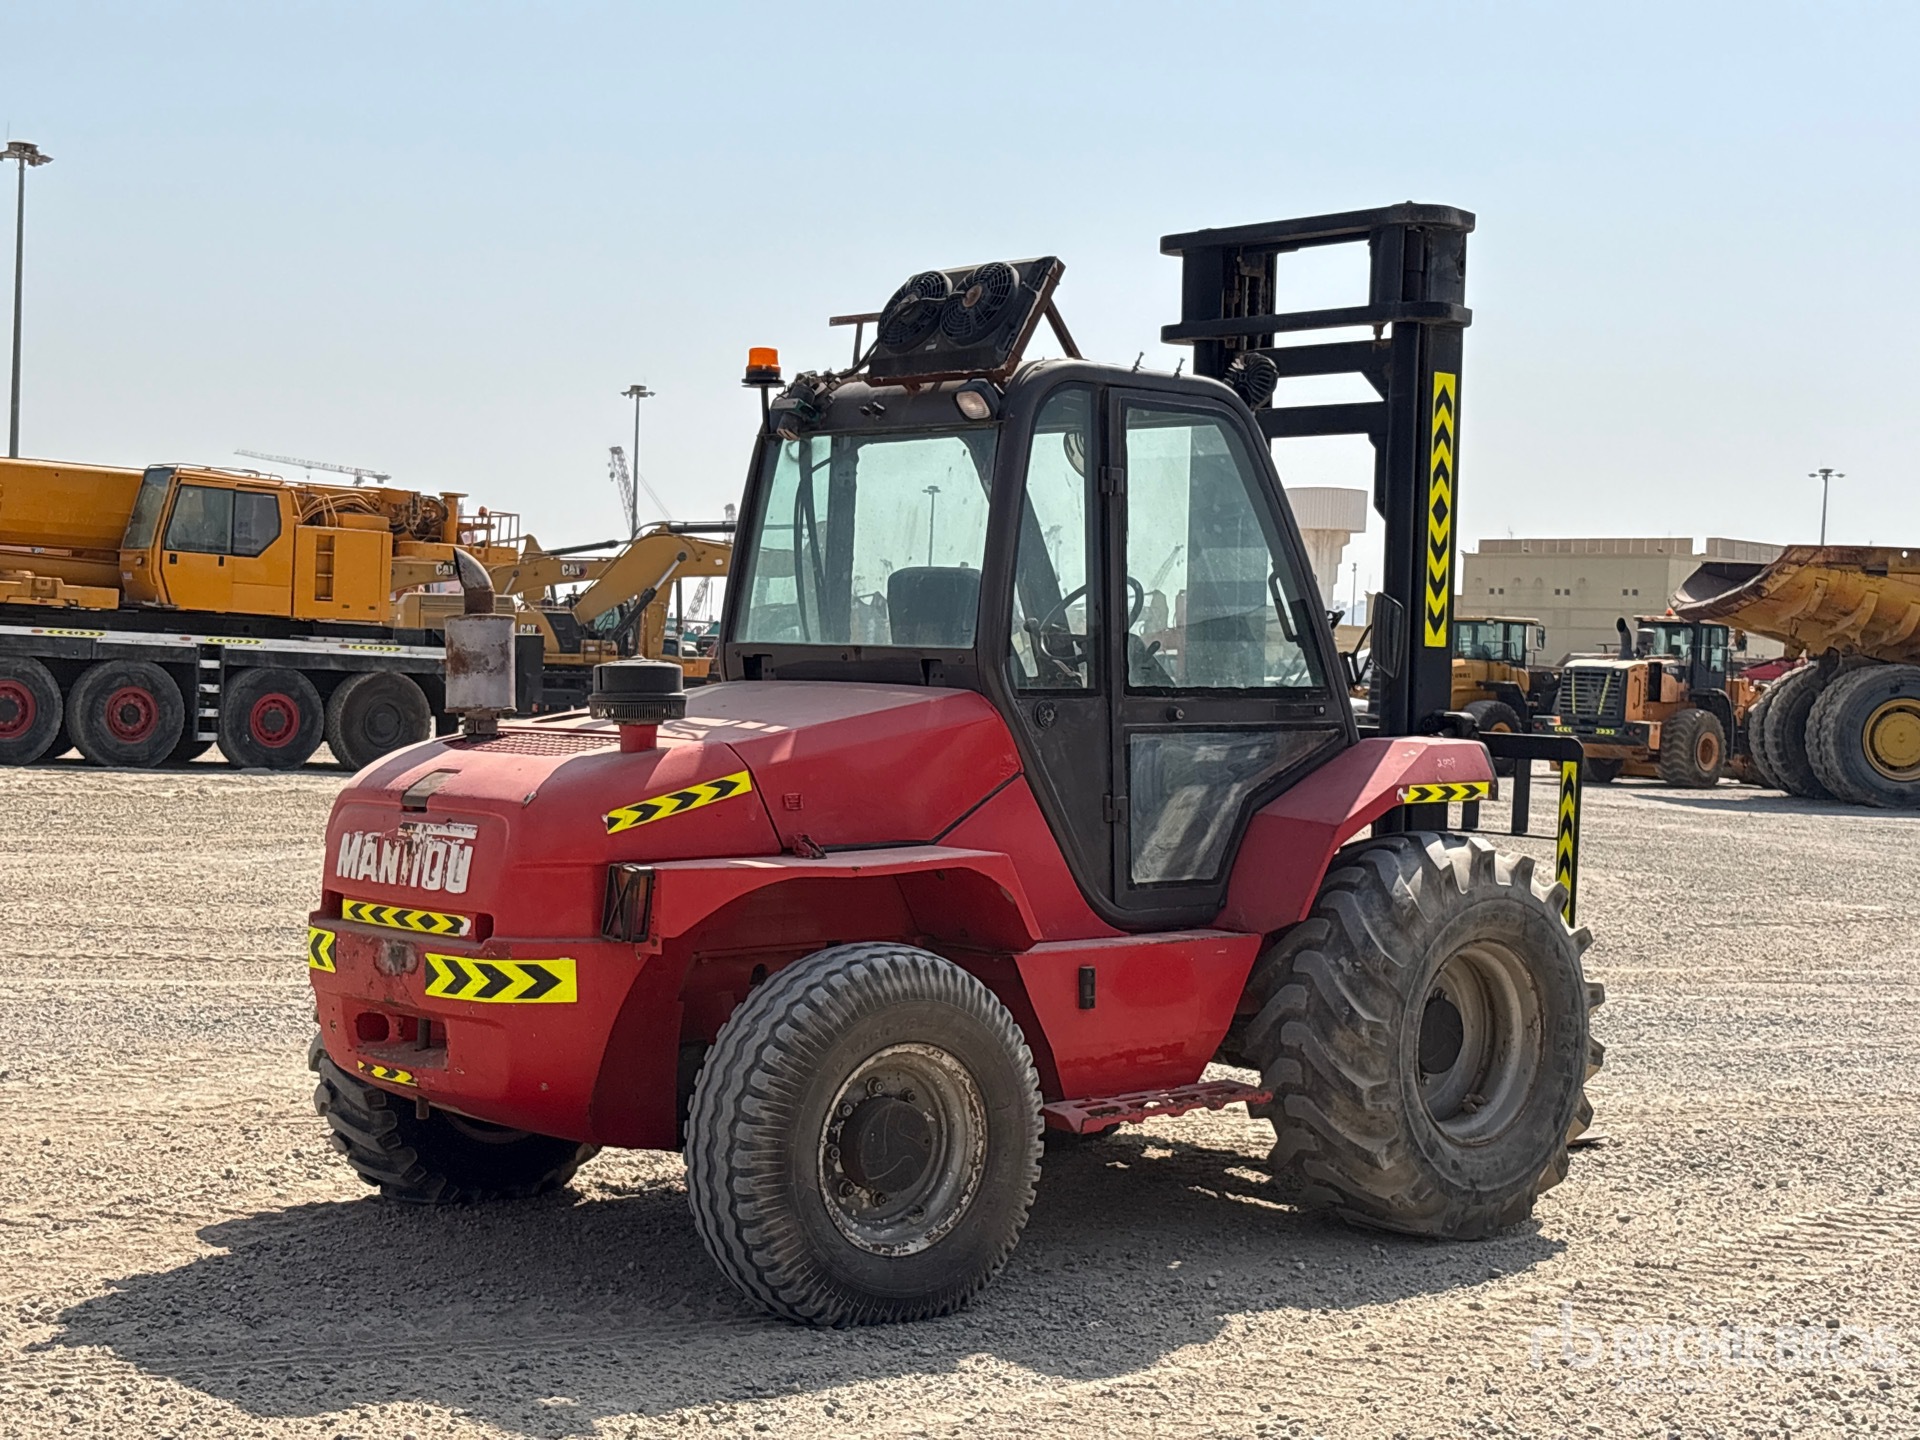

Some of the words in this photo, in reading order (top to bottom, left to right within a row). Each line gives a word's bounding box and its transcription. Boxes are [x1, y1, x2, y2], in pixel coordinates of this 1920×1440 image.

[435, 563, 454, 576] CAT
[561, 563, 582, 576] CAT
[520, 624, 536, 634] CAT
